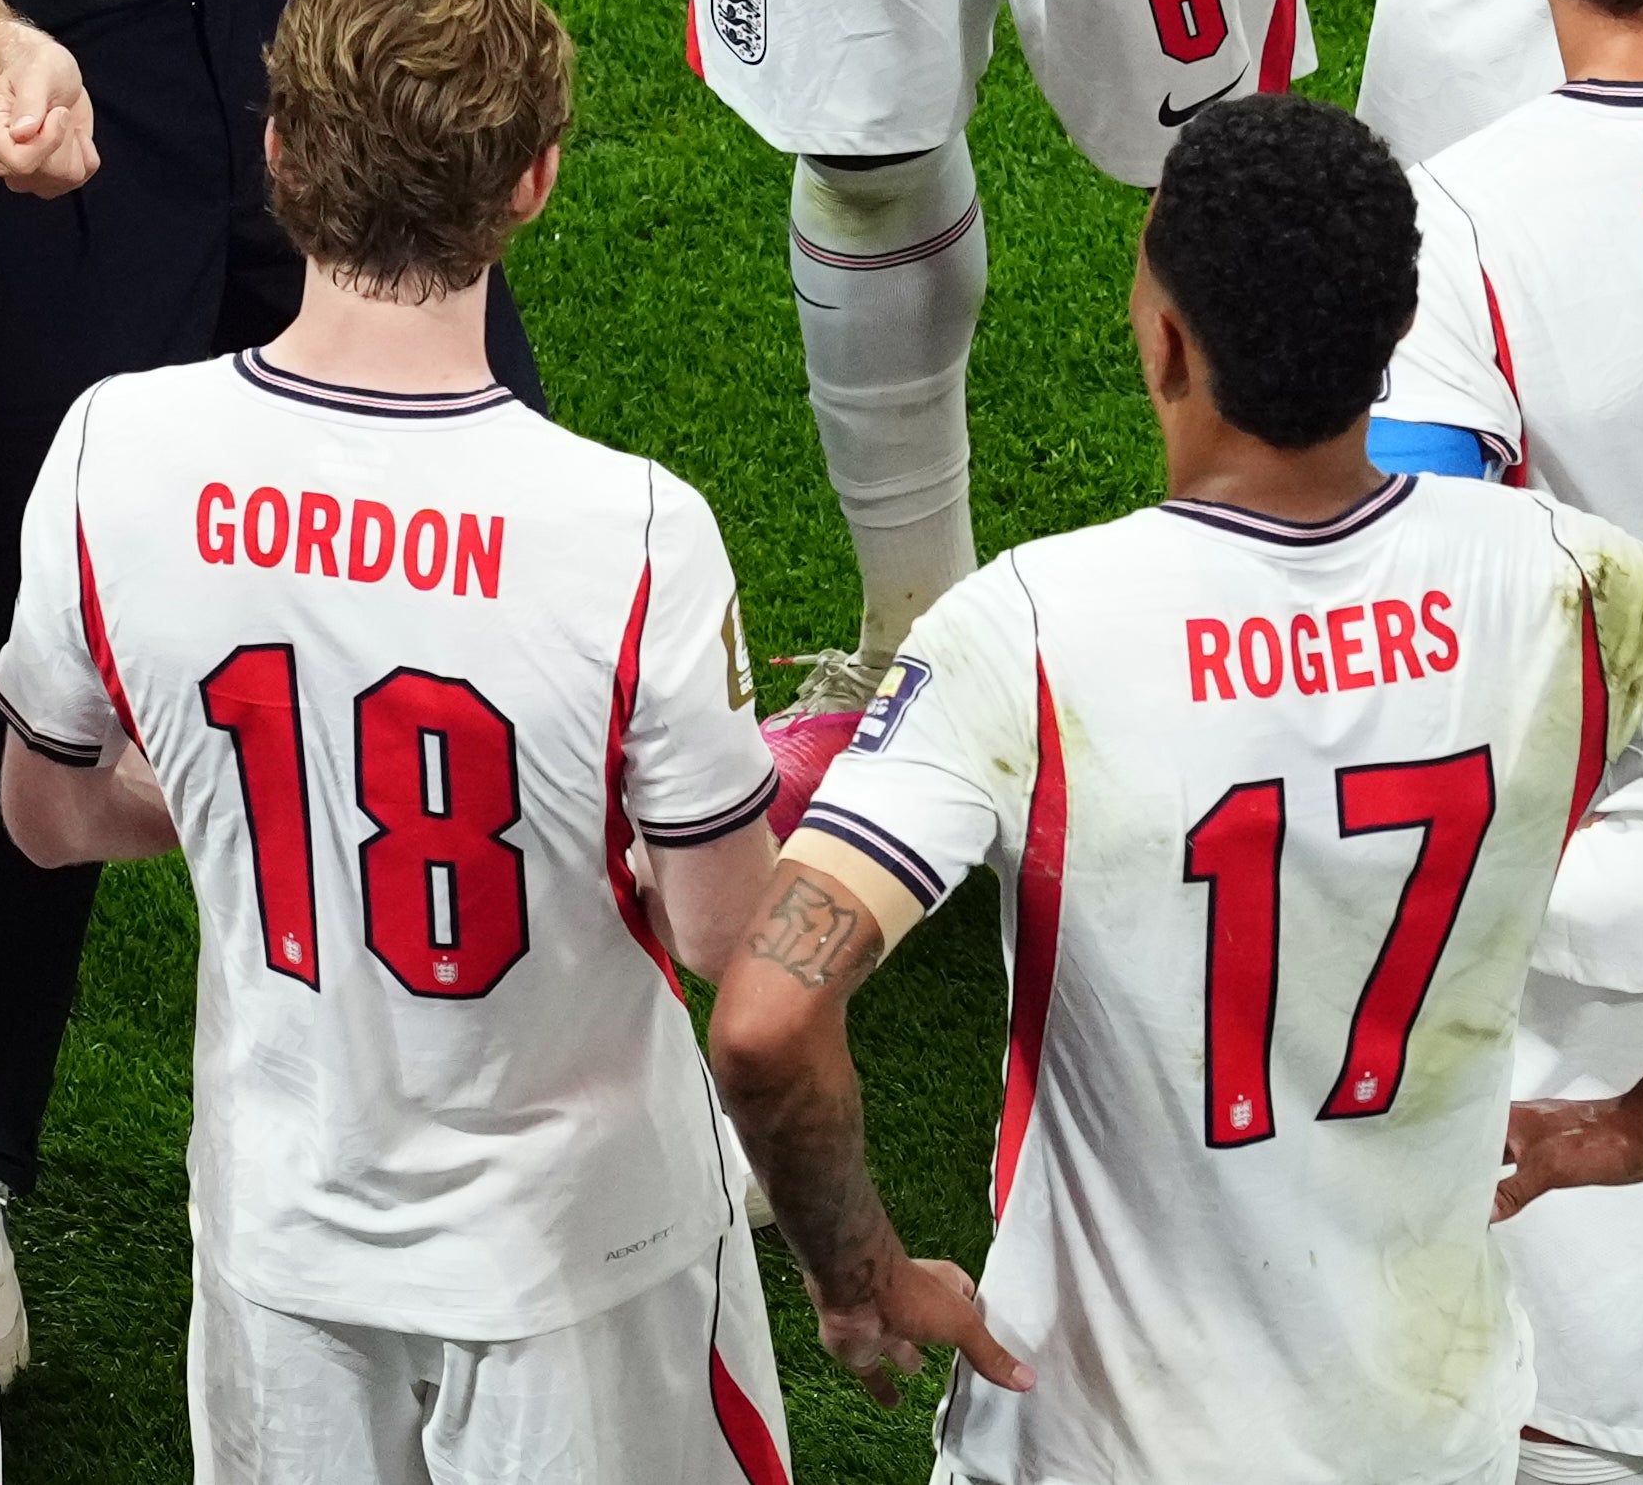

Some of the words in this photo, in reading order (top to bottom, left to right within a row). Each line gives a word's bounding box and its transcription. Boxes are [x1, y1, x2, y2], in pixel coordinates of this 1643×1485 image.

[196, 481, 505, 599] GORDON
[1186, 590, 1460, 702] ROGERS
[199, 643, 530, 999] 18
[1183, 744, 1495, 1148] 17
